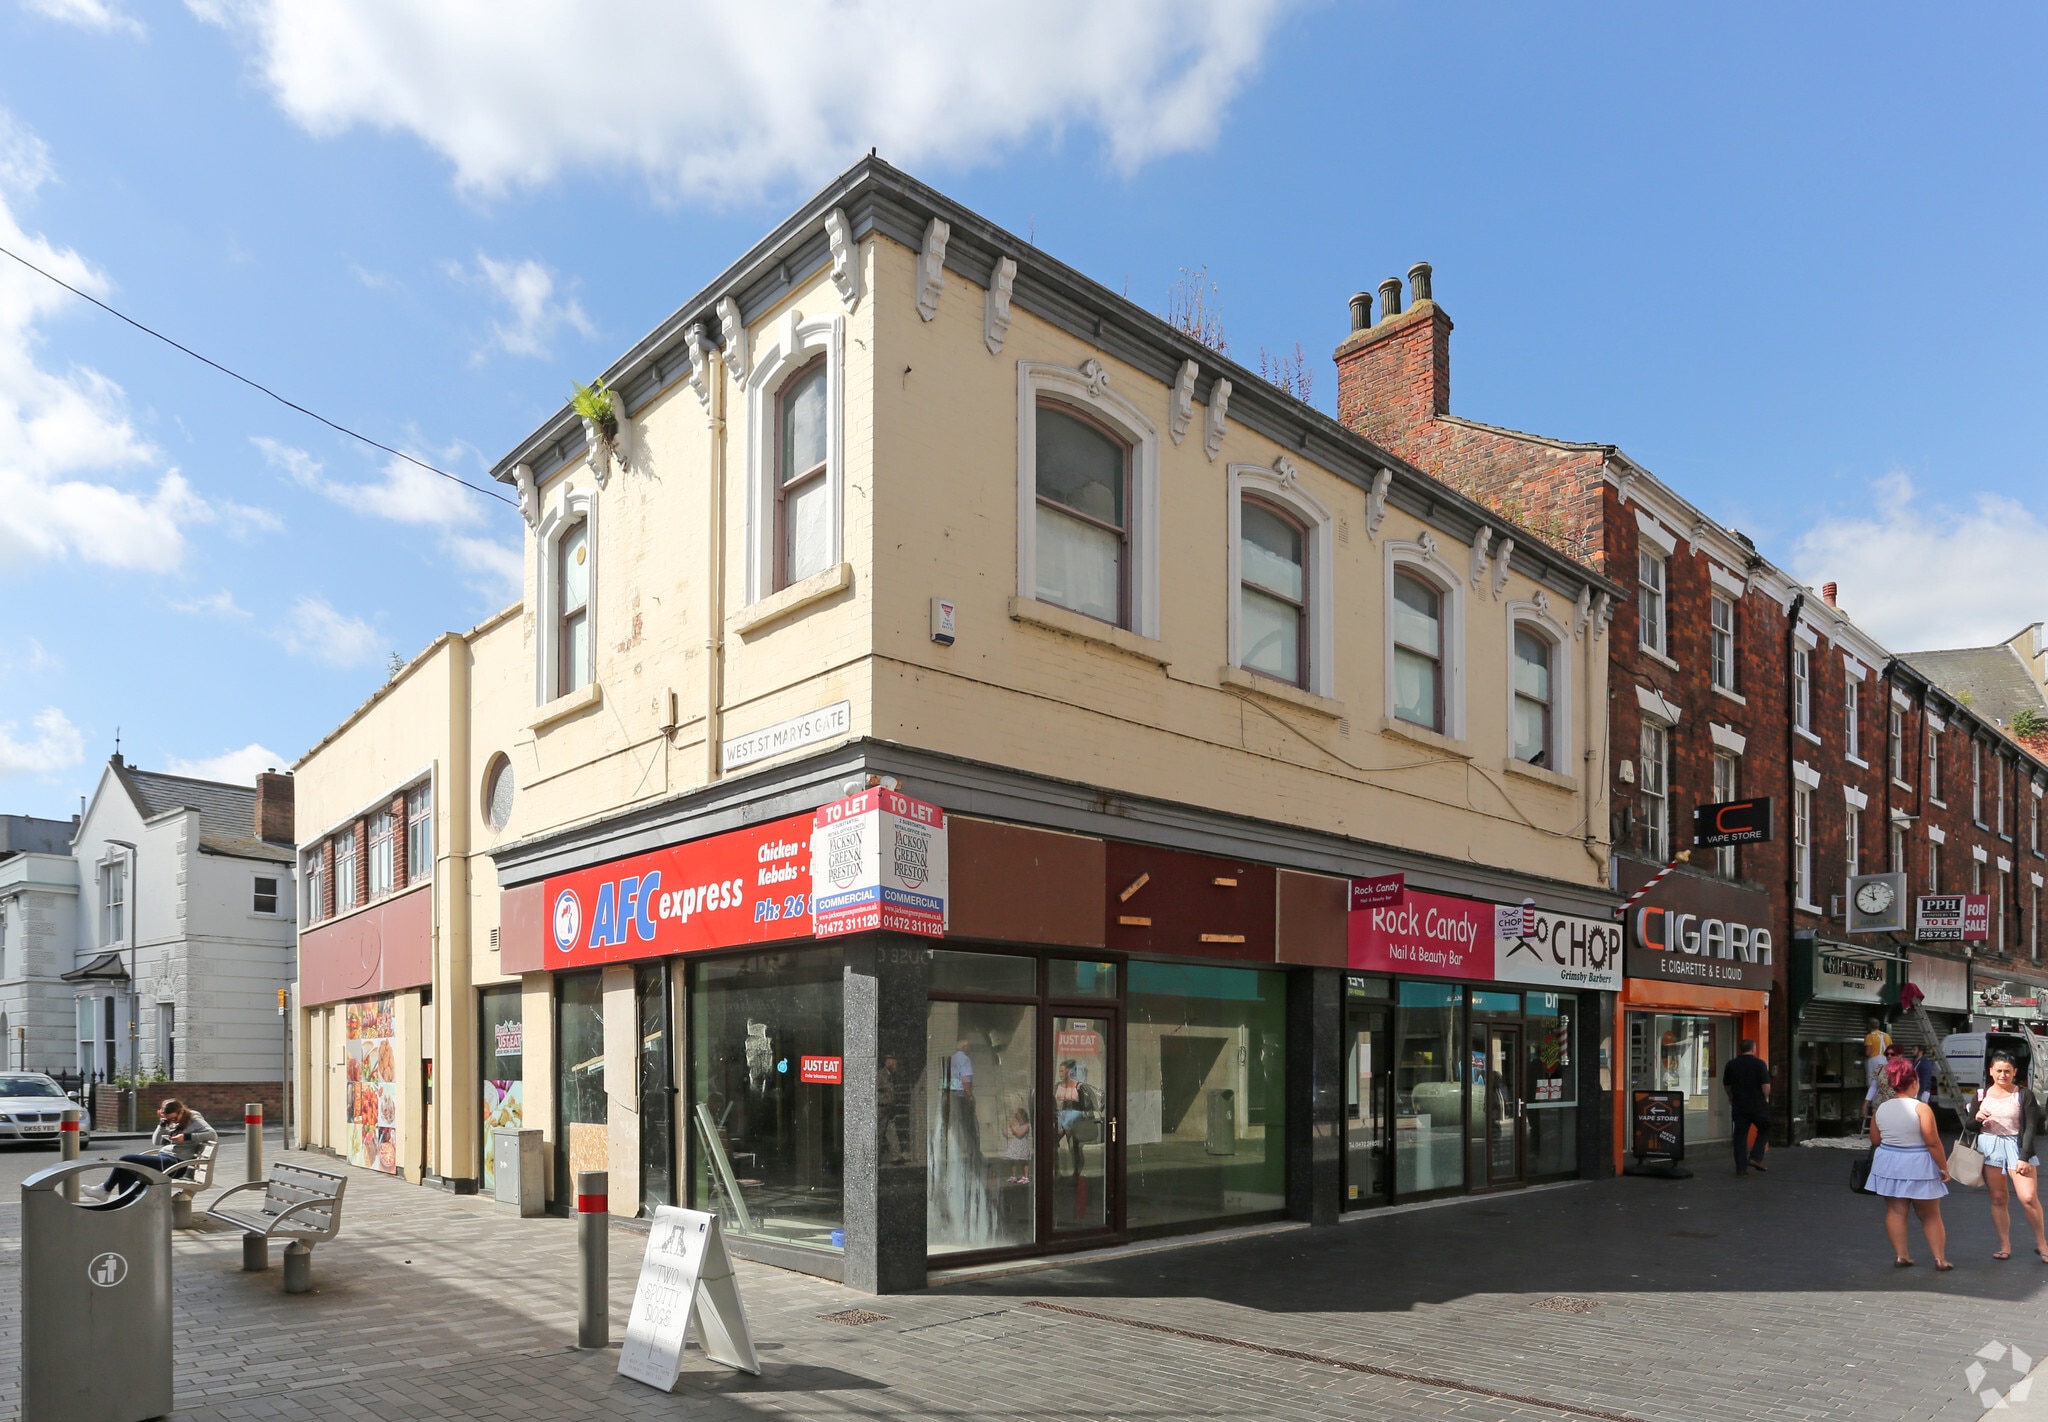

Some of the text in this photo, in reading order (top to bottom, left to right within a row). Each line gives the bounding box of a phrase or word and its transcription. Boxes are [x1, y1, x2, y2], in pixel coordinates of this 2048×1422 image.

[774, 722, 810, 747] MARYS
[815, 710, 844, 733] GATE
[826, 794, 869, 823] TO LET
[890, 795, 934, 823] TO LET
[902, 820, 926, 830] SUBSTANTIAL
[829, 831, 862, 851] JACKSON
[895, 831, 928, 852] JACKSON
[1707, 830, 1762, 843] VAPE STORE
[758, 839, 798, 864] Chicken
[757, 862, 798, 886] Kebabs
[829, 862, 863, 883] PRESTON
[895, 862, 929, 882] PRESTON
[1354, 882, 1399, 895] Rock Candy
[588, 870, 744, 949] AFC express
[754, 898, 780, 924] Ph:
[782, 894, 805, 919] 26
[819, 889, 875, 910] COMMERCIAL
[884, 890, 940, 910] COMMERCIAL
[1926, 900, 1957, 910] PPH
[1967, 904, 1986, 916] FOR
[818, 914, 878, 935] 01472 311120
[884, 914, 942, 935] 01472 311120
[1372, 902, 1478, 953] Rock Candy
[1498, 918, 1522, 927] CHOP
[1924, 918, 1959, 926] TO LET
[1964, 920, 1986, 932] SALE
[1552, 920, 1620, 972] CHOP
[1637, 906, 1772, 966] CIGARA
[1390, 943, 1464, 968] Nail & Beauty Bar
[1560, 970, 1612, 984] Grimsby Barbers
[1661, 959, 1742, 980] E CIGARETTE & E LIQUID
[1058, 1034, 1096, 1046] JUST EAT
[803, 1060, 840, 1072] JUST EAT
[1660, 1134, 1676, 1144] DEALS
[1662, 1130, 1676, 1140] MEGA
[657, 1264, 680, 1286] TWO
[645, 1283, 682, 1308] SPOTTY
[644, 1304, 672, 1328] DOGS
